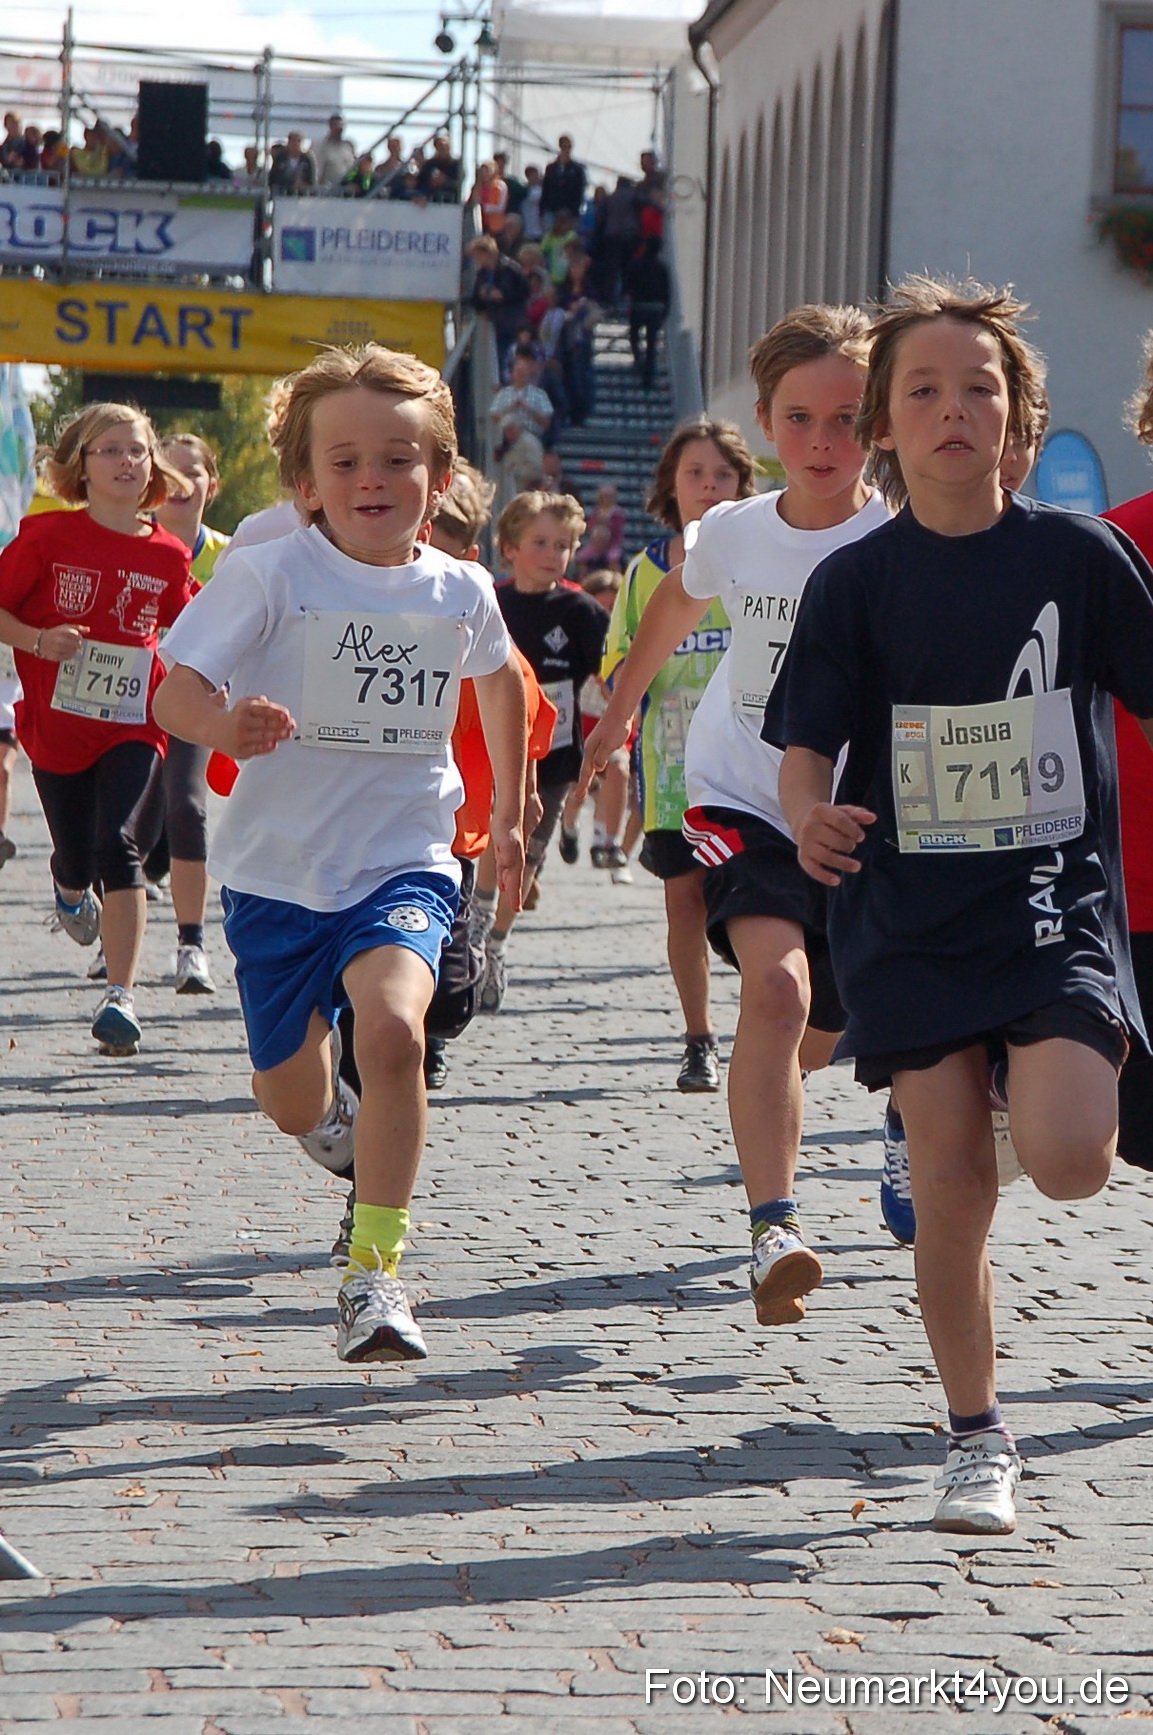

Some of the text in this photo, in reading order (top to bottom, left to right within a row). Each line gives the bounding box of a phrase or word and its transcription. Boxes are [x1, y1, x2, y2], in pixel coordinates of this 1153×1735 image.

[322, 227, 449, 254] PFLEIDERER
[56, 298, 254, 350] START
[59, 571, 92, 583] IMMER
[59, 580, 92, 594] WIEDER
[59, 587, 88, 604] NEU
[89, 646, 124, 667] Fanny
[332, 621, 418, 665] Alex
[86, 670, 141, 698] 7159
[354, 666, 451, 708] 7317
[940, 718, 1012, 746] Josua
[900, 763, 911, 784] K
[946, 751, 1065, 803] 7119
[1015, 815, 1083, 838] PFLEIDERER
[1028, 842, 1066, 948] RAIL
